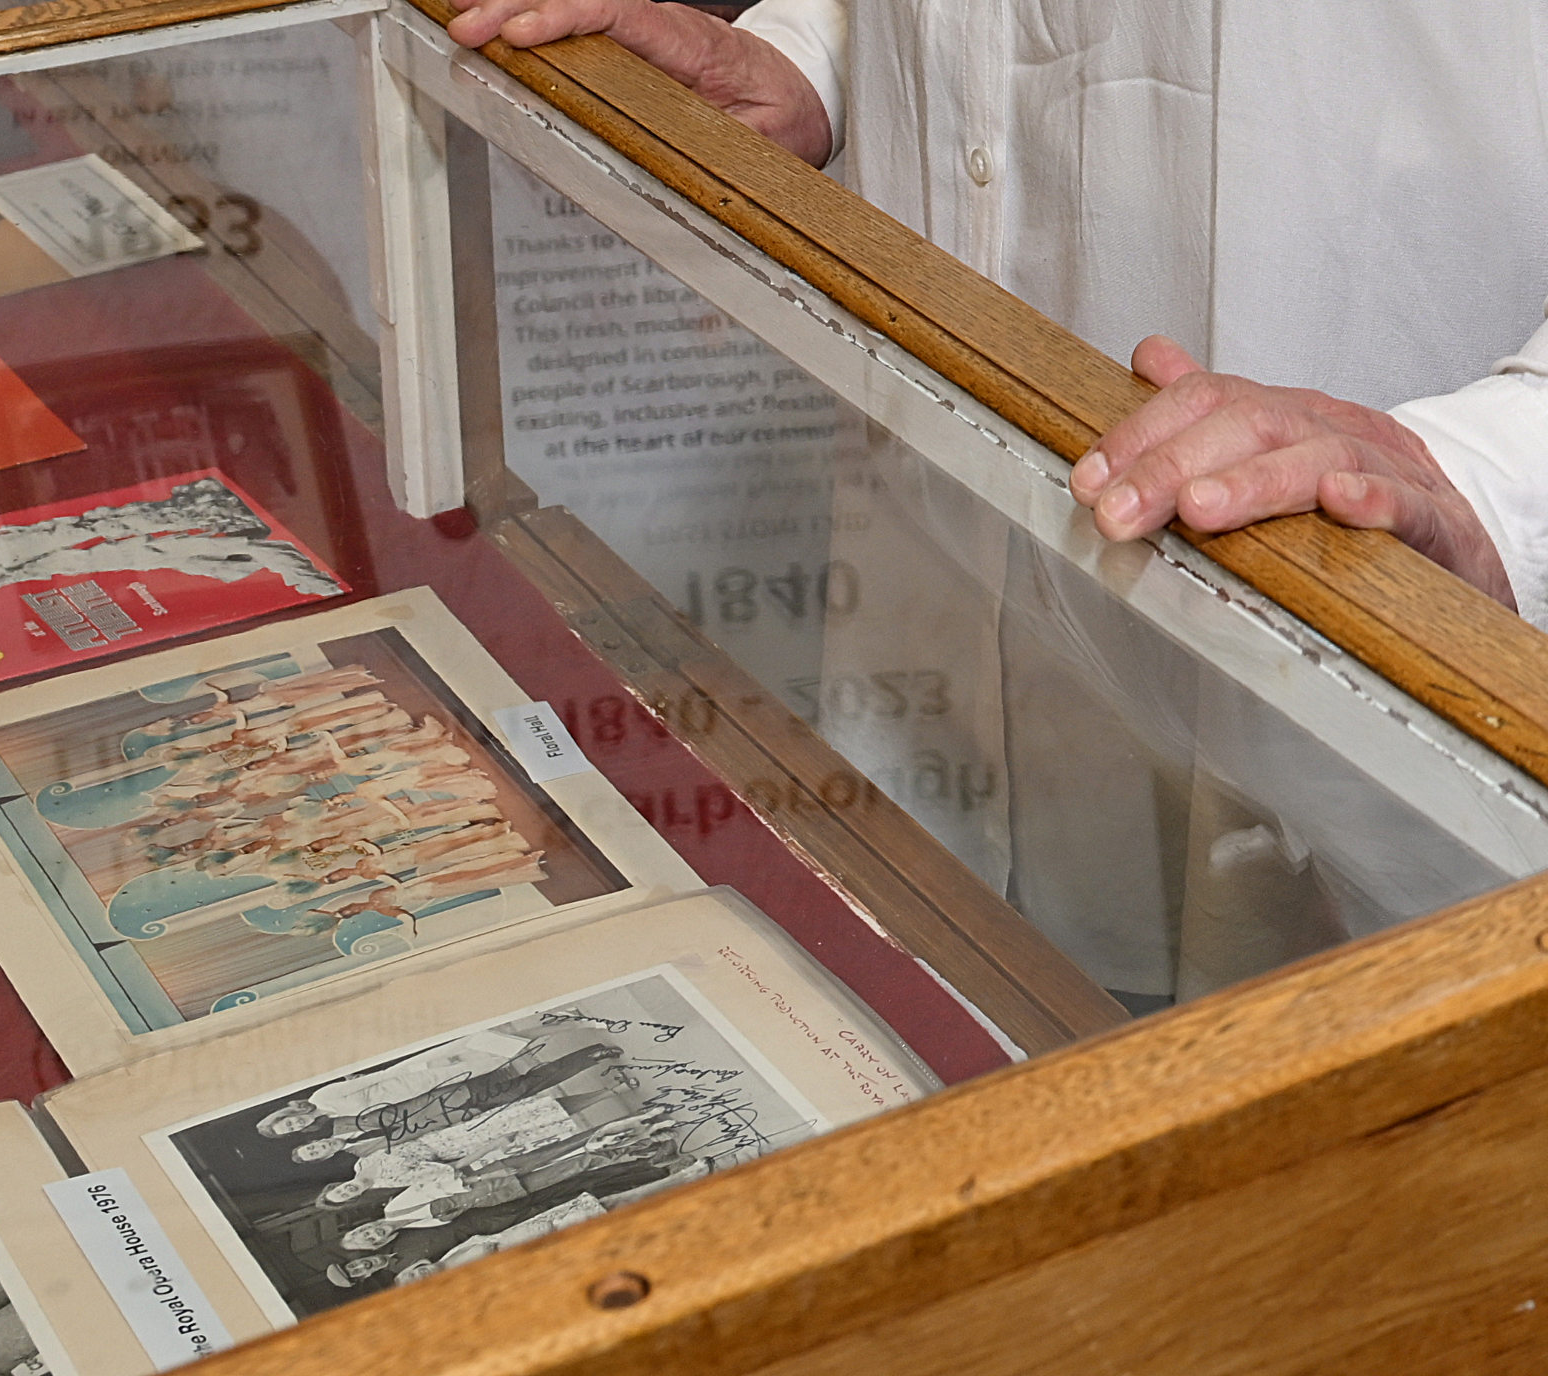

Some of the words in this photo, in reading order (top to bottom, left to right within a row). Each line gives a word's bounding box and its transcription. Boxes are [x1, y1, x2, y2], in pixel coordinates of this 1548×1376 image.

[523, 715, 547, 734] Hall
[535, 732, 564, 758] Floral
[87, 1184, 120, 1214] 1976
[111, 1214, 149, 1257] House
[138, 1255, 174, 1296] Opera
[160, 1295, 201, 1335] Royal
